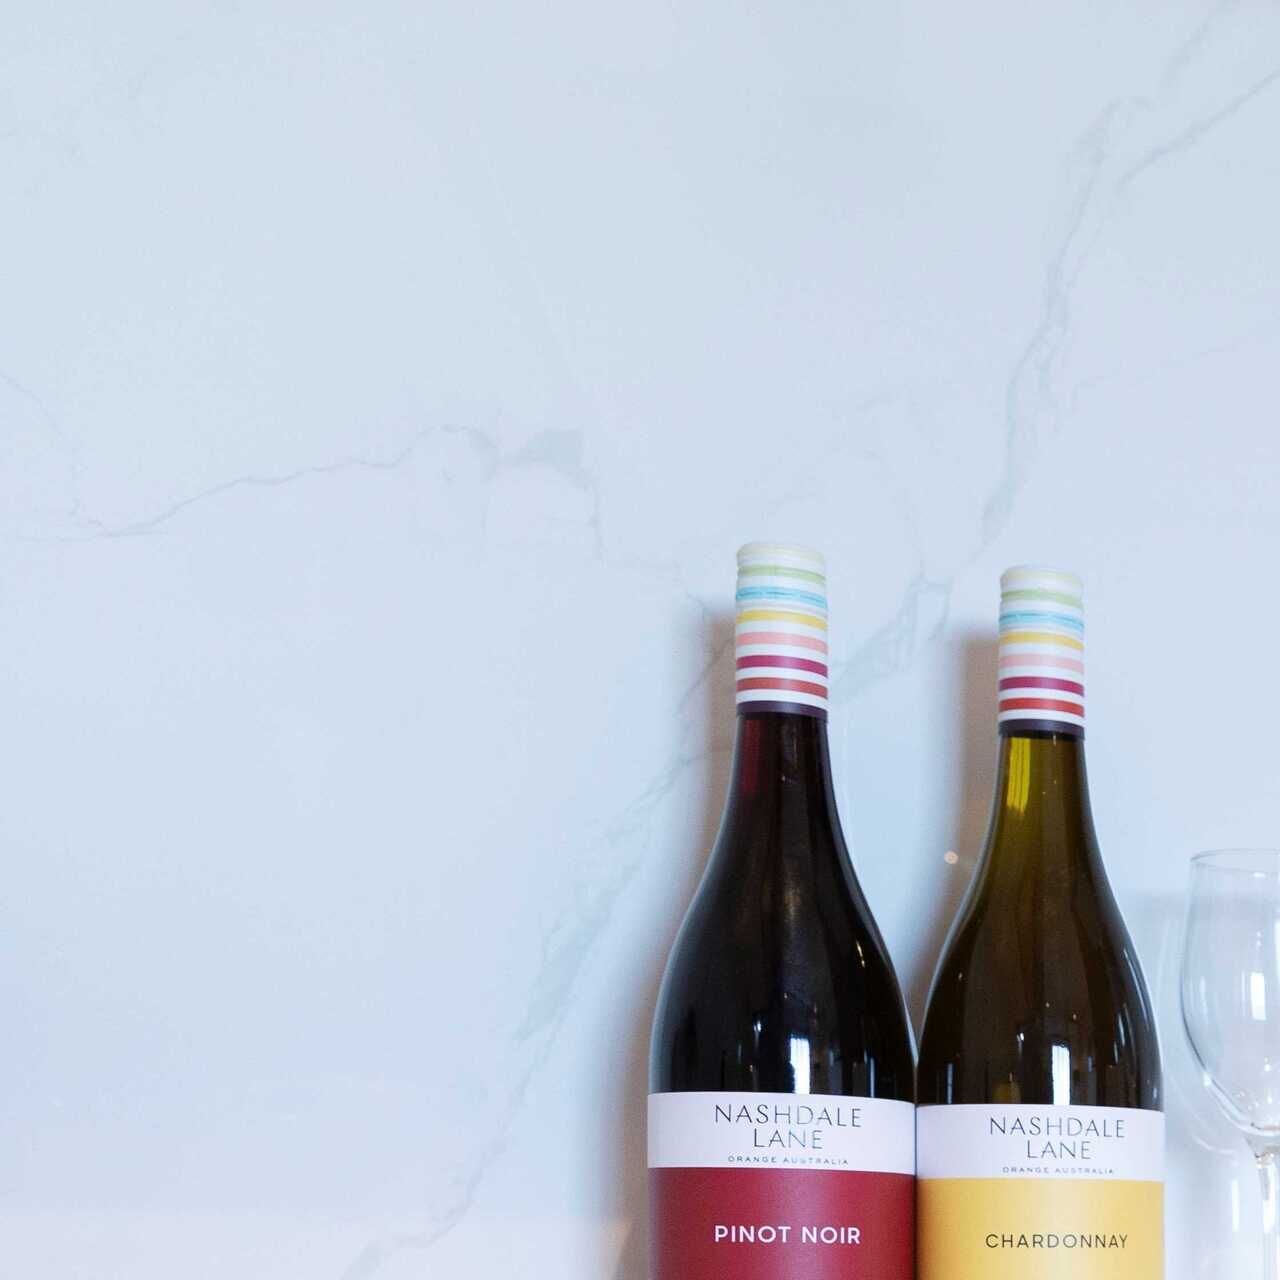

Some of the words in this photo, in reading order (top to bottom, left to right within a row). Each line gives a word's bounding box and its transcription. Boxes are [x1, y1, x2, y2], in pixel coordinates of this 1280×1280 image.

[715, 1104, 862, 1128] NASHDALE
[990, 1116, 1125, 1138] NASHDALE
[753, 1128, 824, 1149] LANE
[1027, 1140, 1091, 1160] LANE
[727, 1155, 777, 1164] ORANGE
[783, 1156, 849, 1165] AUSTRALIA
[1002, 1166, 1049, 1174] ORANGE
[1055, 1167, 1114, 1175] AUSTRALIA
[714, 1225, 792, 1243] PINOT
[801, 1226, 861, 1244] NOIR
[985, 1233, 1128, 1249] CHARDONNAY
